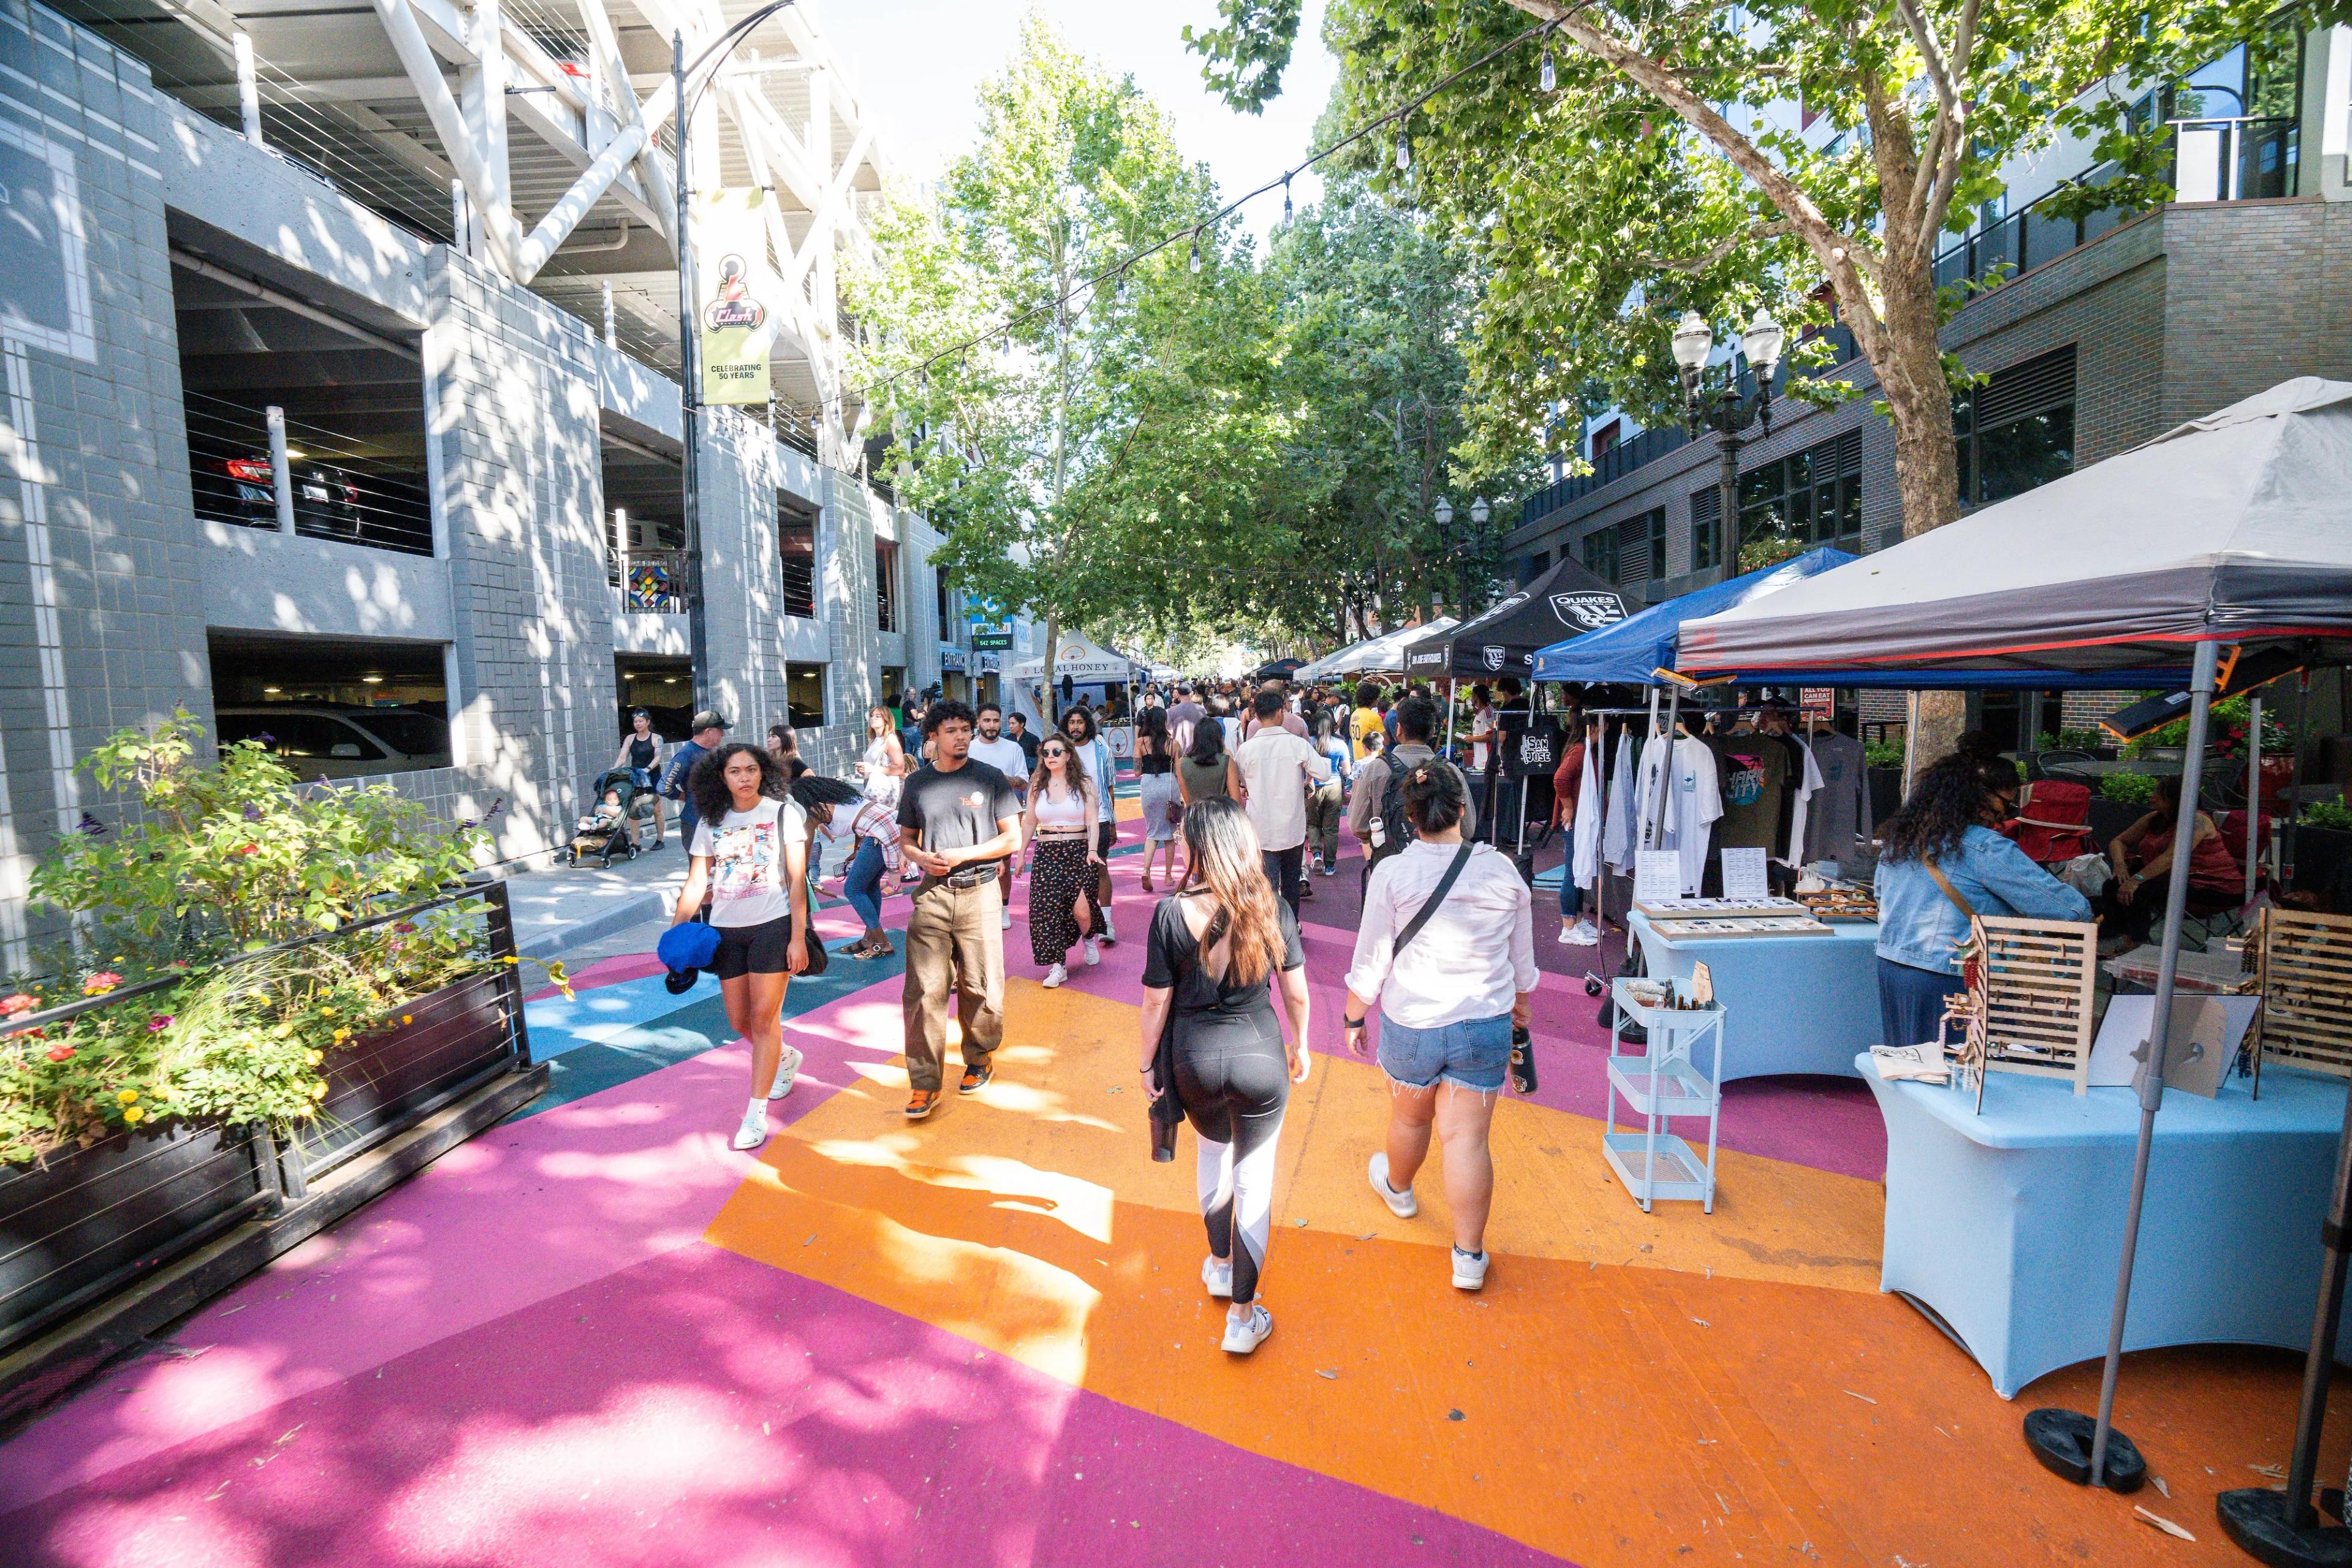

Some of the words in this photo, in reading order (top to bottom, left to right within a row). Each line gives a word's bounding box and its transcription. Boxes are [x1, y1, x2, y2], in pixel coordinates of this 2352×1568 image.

[715, 308, 753, 322] Clash
[711, 364, 761, 372] CELEBRATING
[944, 652, 966, 666] ENTRANC
[1351, 724, 1360, 741] 30
[1528, 736, 1548, 749] SAN
[1526, 750, 1551, 762] JOSE
[1725, 783, 1758, 799] CITY
